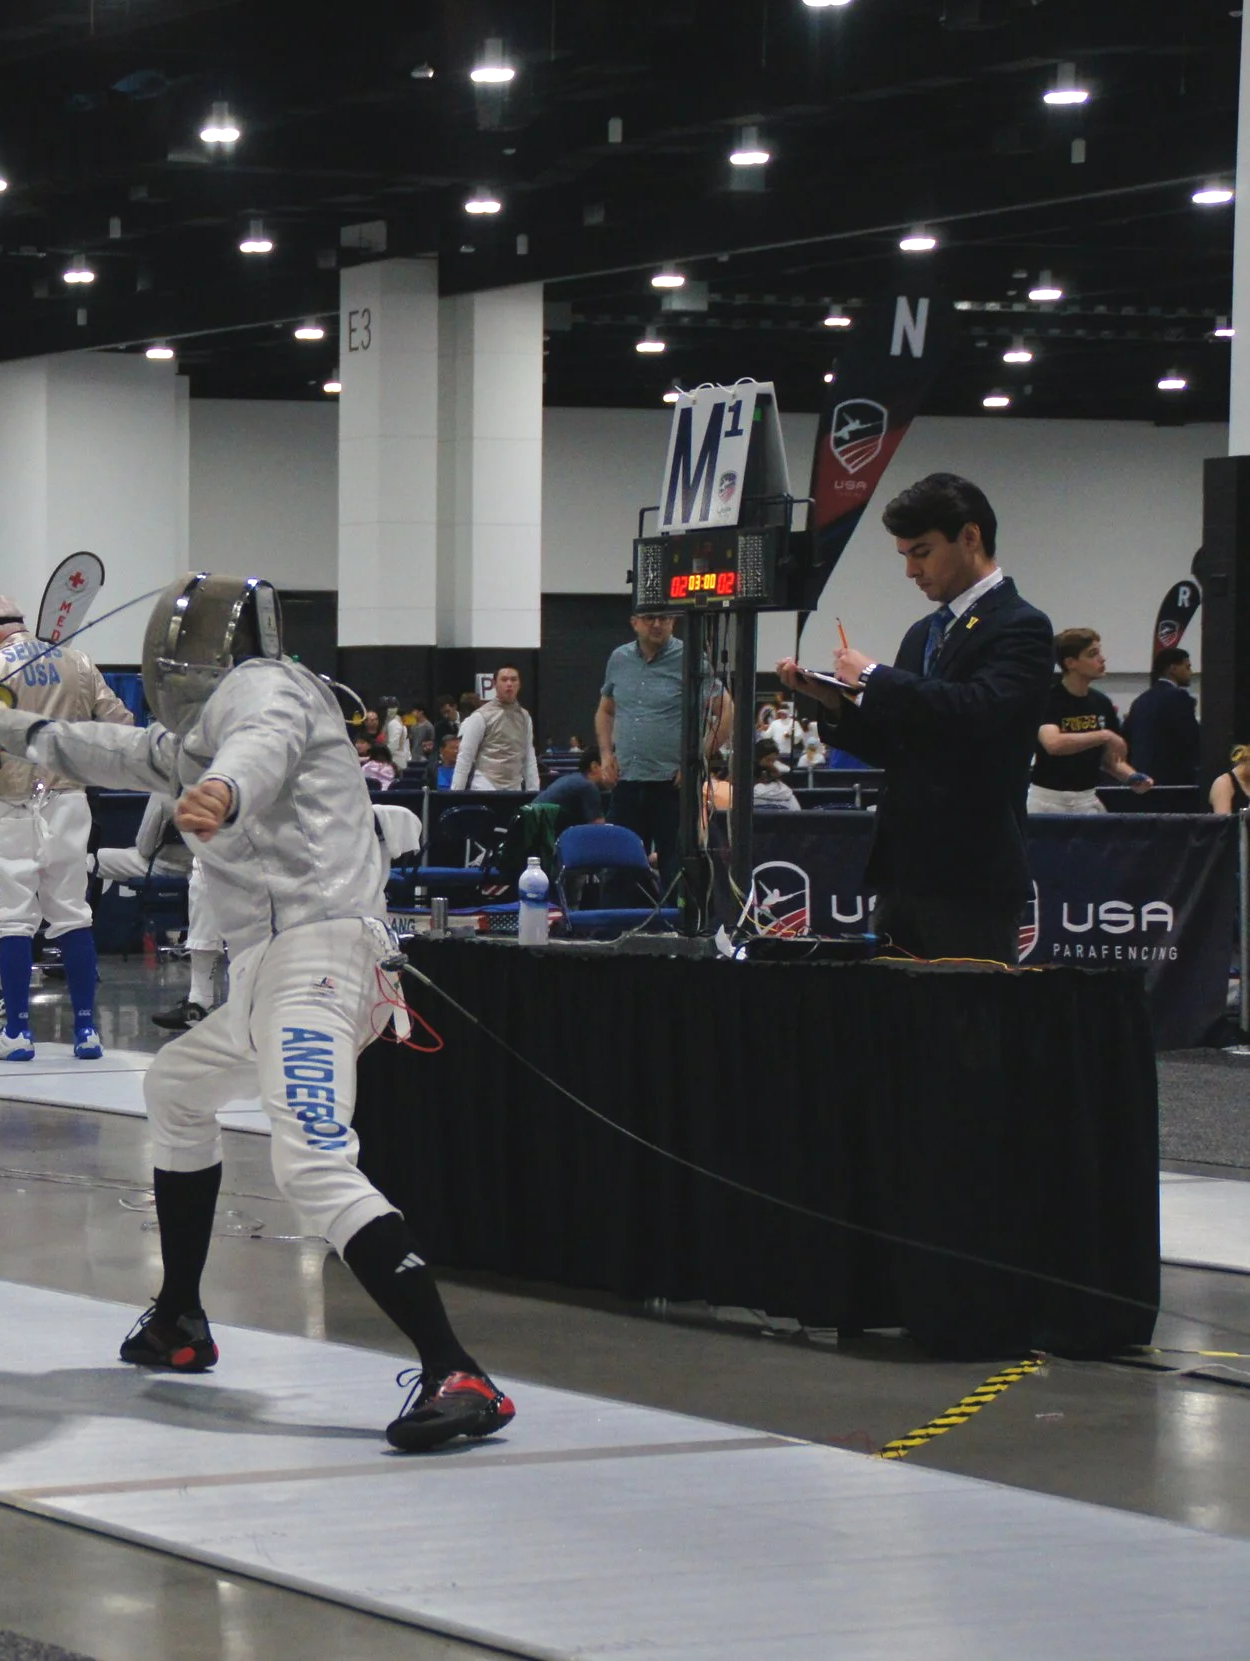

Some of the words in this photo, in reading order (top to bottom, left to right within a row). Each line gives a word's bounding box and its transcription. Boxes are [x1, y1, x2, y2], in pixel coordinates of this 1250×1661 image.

[349, 307, 372, 353] E3
[890, 295, 930, 358] N
[670, 576, 688, 598] 02
[688, 573, 716, 591] 03:00
[717, 572, 735, 594] 02
[1178, 586, 1191, 608] R
[51, 600, 73, 642] MED
[22, 662, 61, 687] USA
[1062, 900, 1174, 934] USA
[1052, 943, 1178, 961] PARAFENCING
